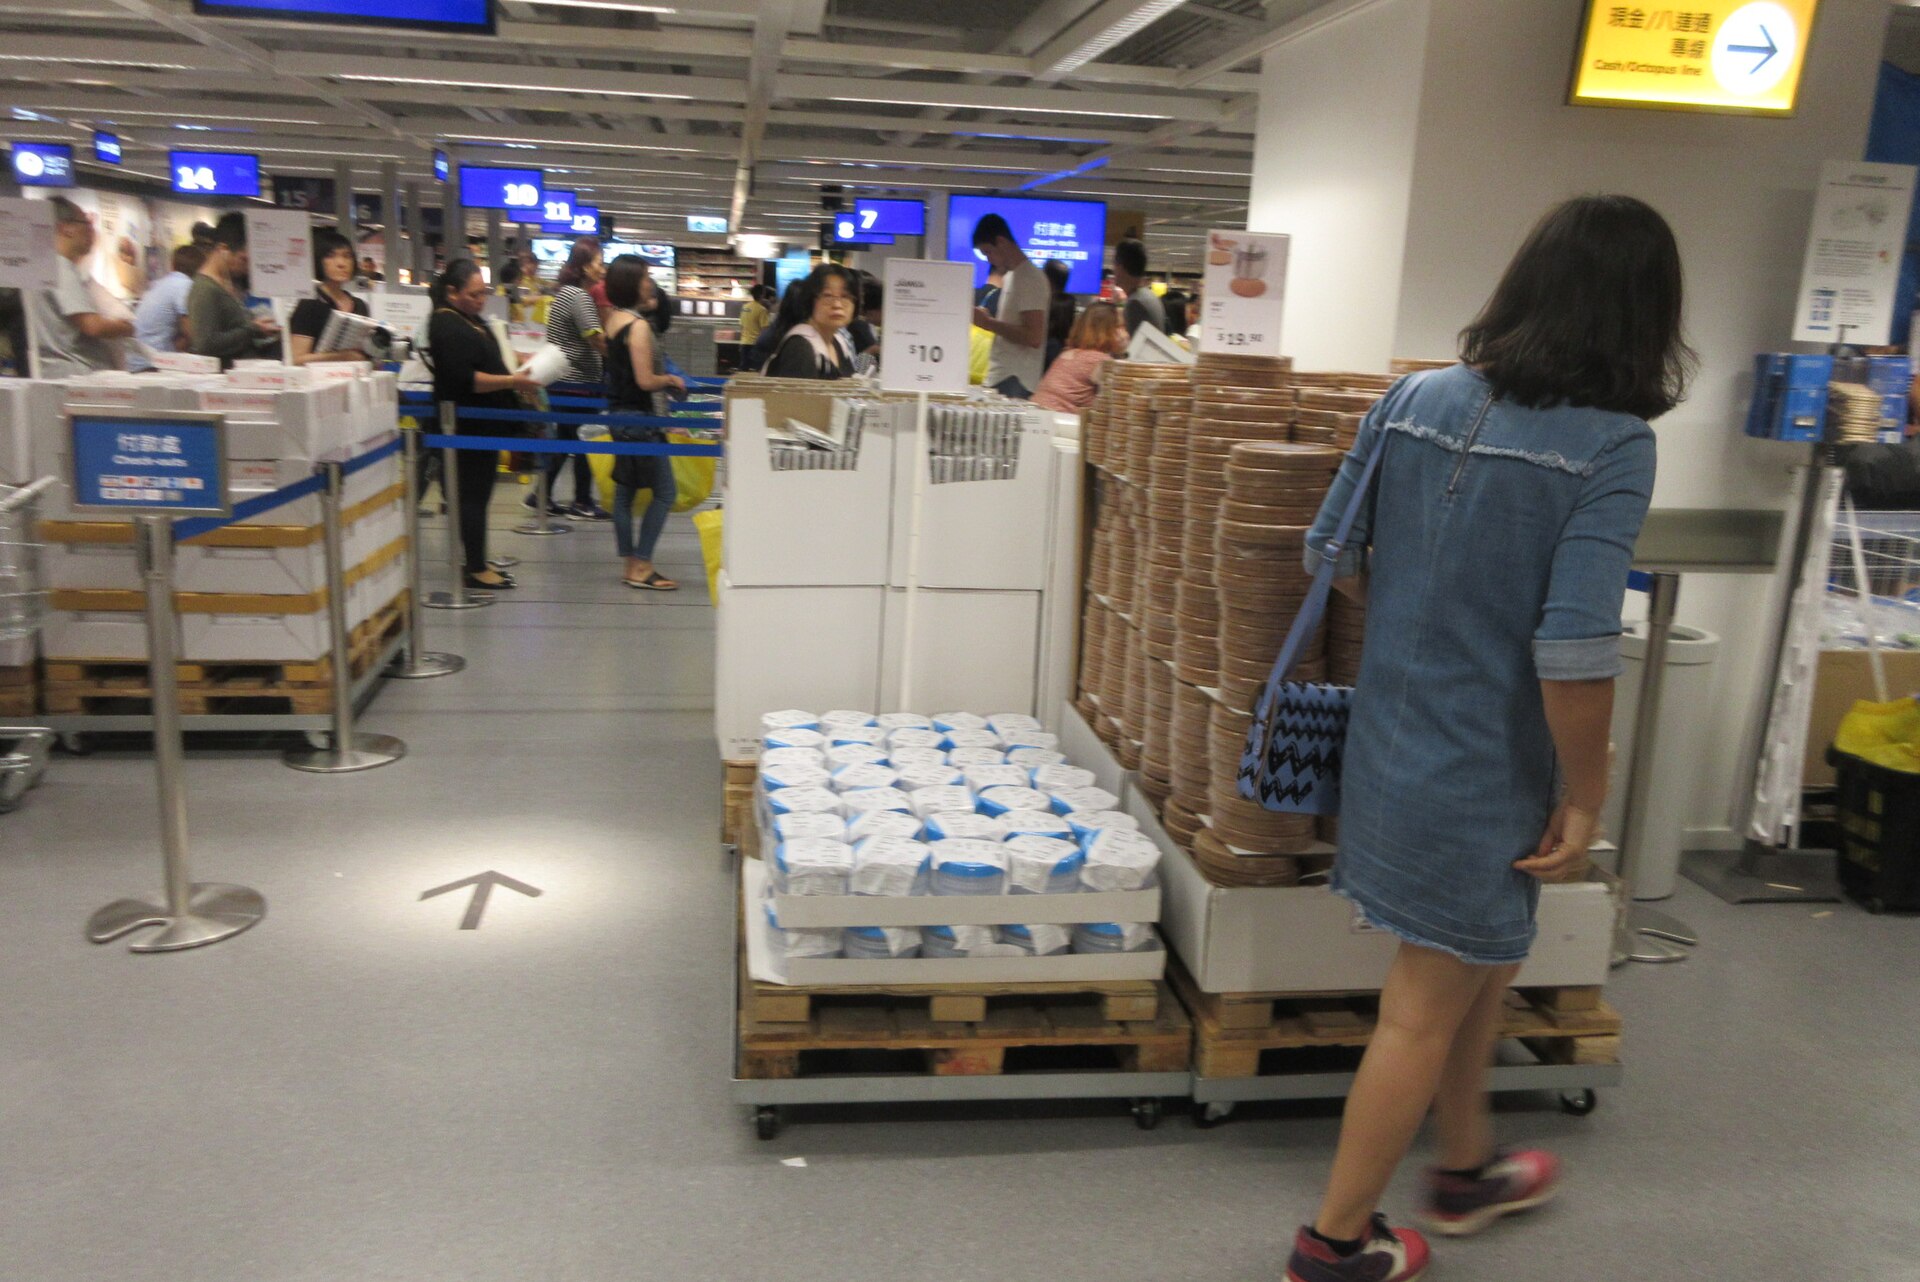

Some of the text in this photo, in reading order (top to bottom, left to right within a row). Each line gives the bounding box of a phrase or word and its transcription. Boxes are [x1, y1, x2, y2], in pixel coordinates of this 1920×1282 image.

[177, 166, 217, 191] 14
[503, 183, 539, 206] 10
[543, 201, 573, 221] 11
[860, 210, 878, 229] 7
[570, 214, 597, 232] 12
[837, 221, 855, 239] 8
[908, 344, 944, 363] $10
